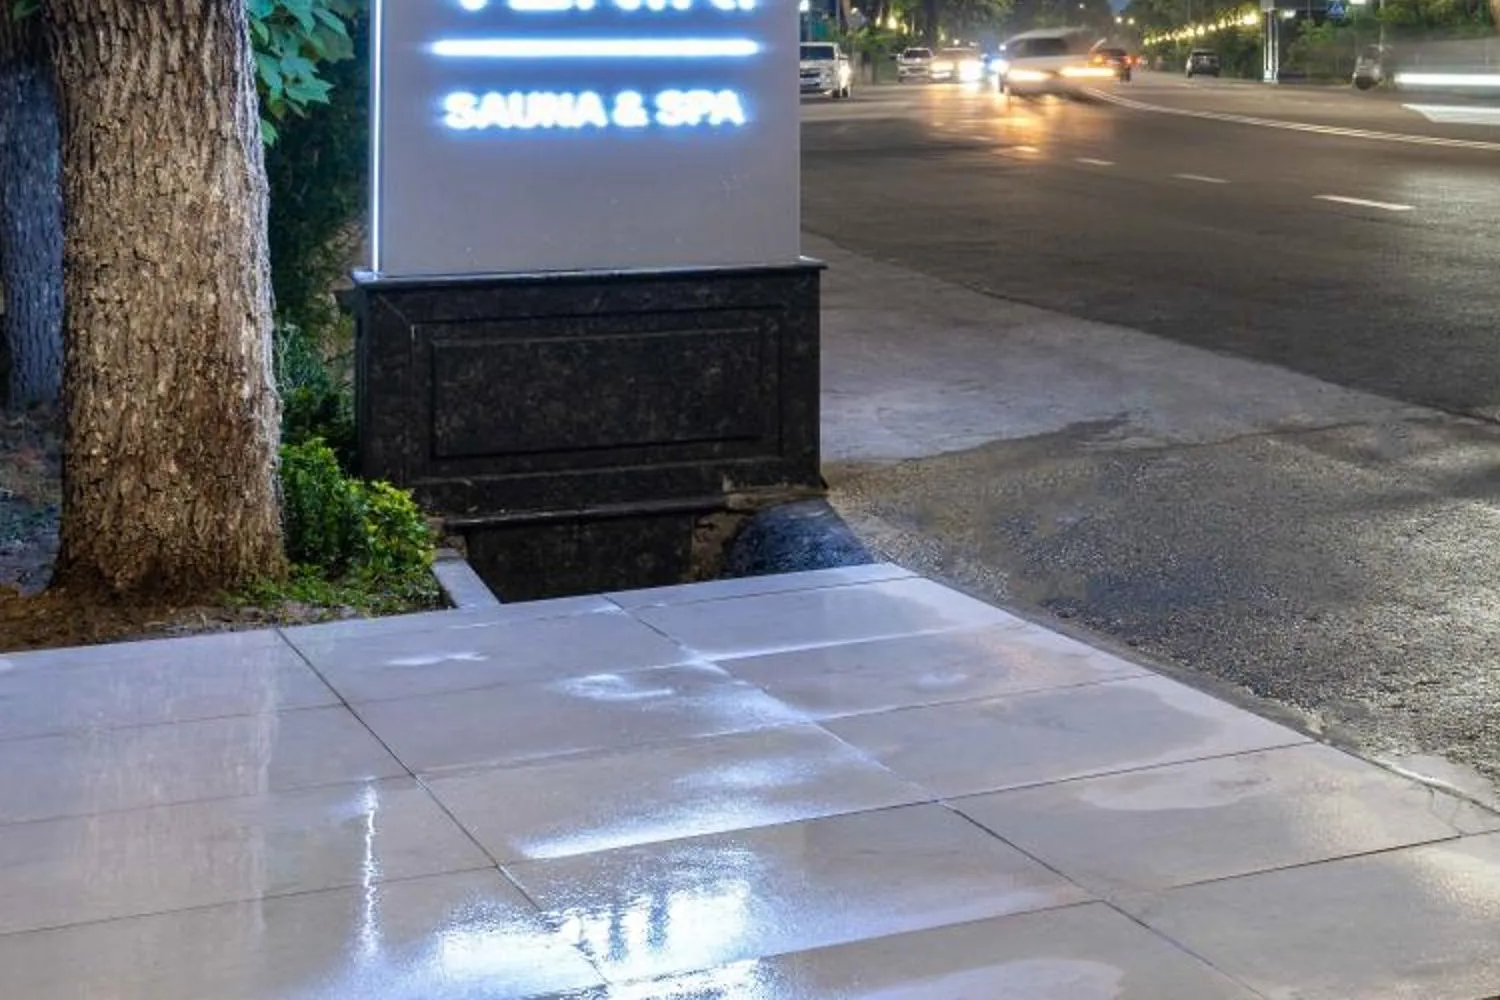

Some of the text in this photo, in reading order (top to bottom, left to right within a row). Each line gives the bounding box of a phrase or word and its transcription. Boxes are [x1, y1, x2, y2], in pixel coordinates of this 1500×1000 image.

[444, 89, 746, 129] SAUNA & SPA
